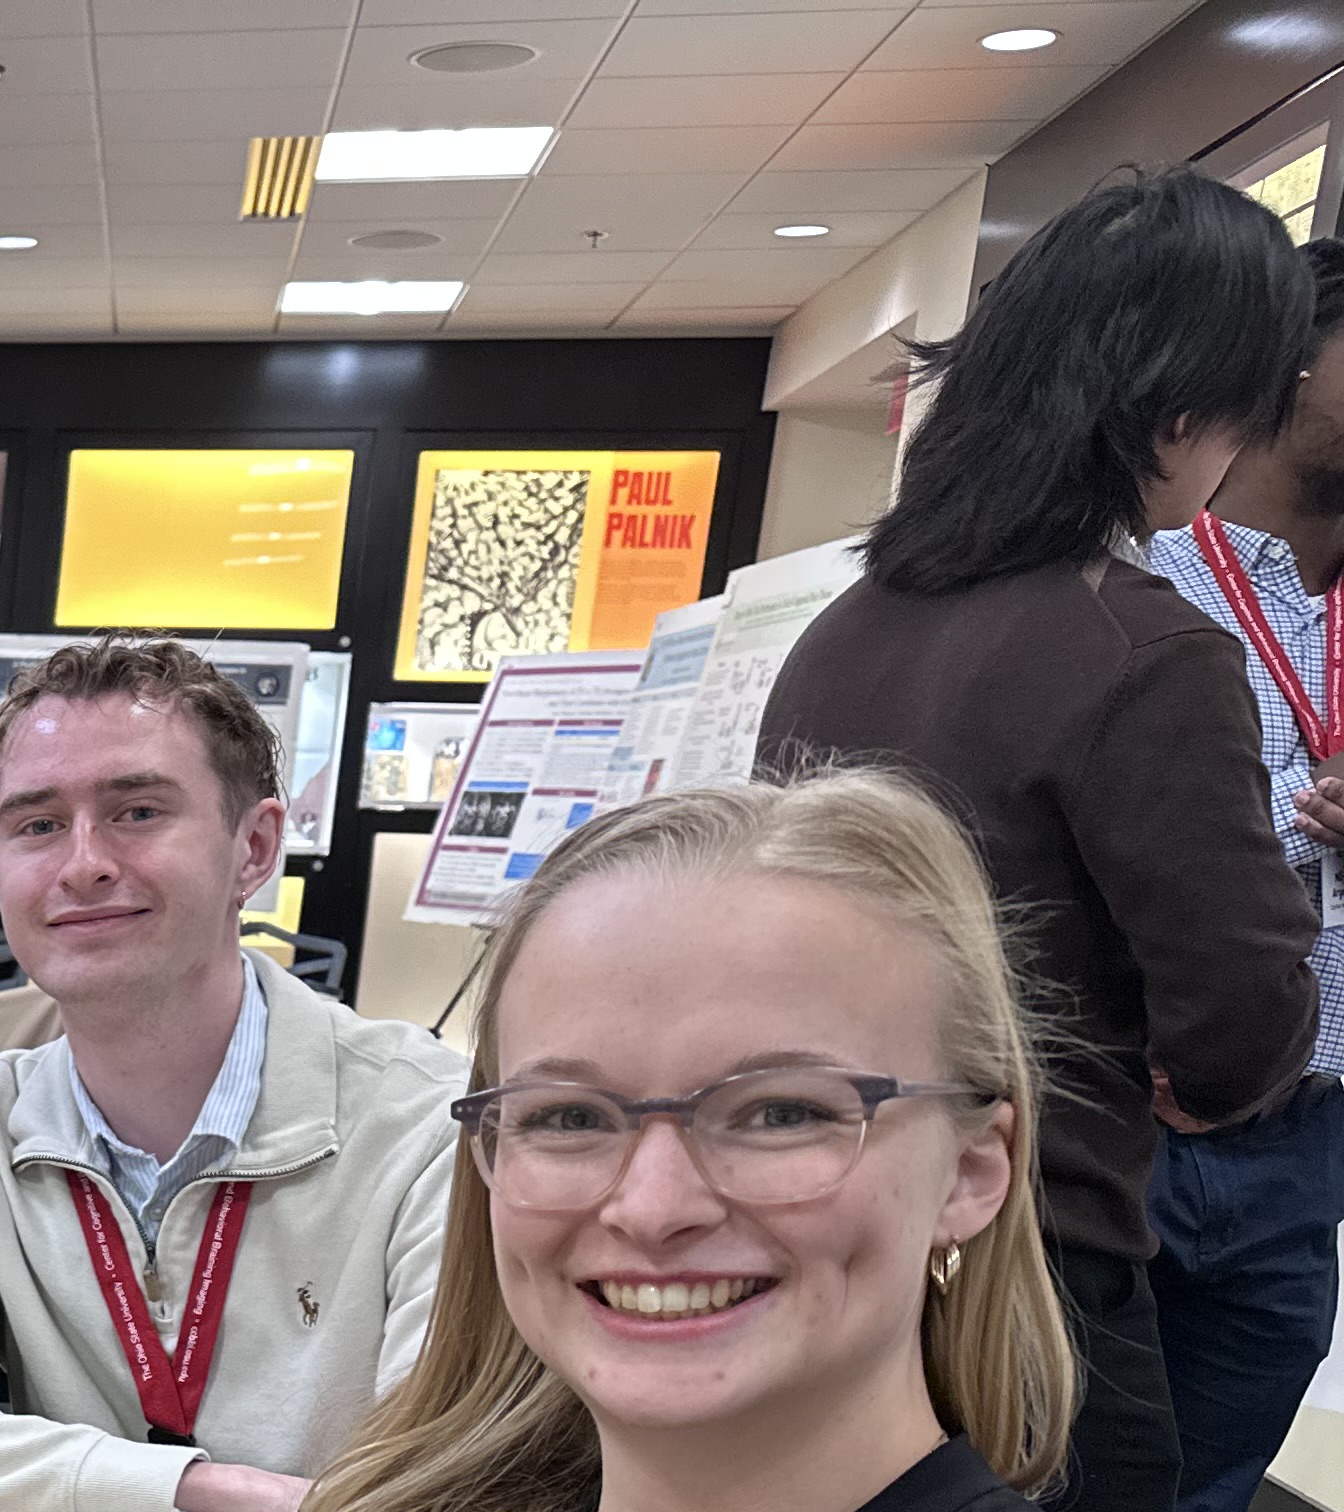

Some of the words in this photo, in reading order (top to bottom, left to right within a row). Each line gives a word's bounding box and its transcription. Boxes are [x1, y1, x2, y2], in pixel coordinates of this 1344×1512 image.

[610, 470, 673, 507] PAUL
[604, 512, 697, 550] PALNIK
[84, 1192, 103, 1231] Cognitive
[213, 1194, 233, 1241] Behavioral
[96, 1230, 106, 1244] for
[99, 1242, 115, 1271] Center
[112, 1280, 133, 1322] University
[192, 1278, 212, 1315] Imaging
[126, 1320, 140, 1344] State
[134, 1342, 148, 1364] Ohio
[141, 1363, 152, 1381] The
